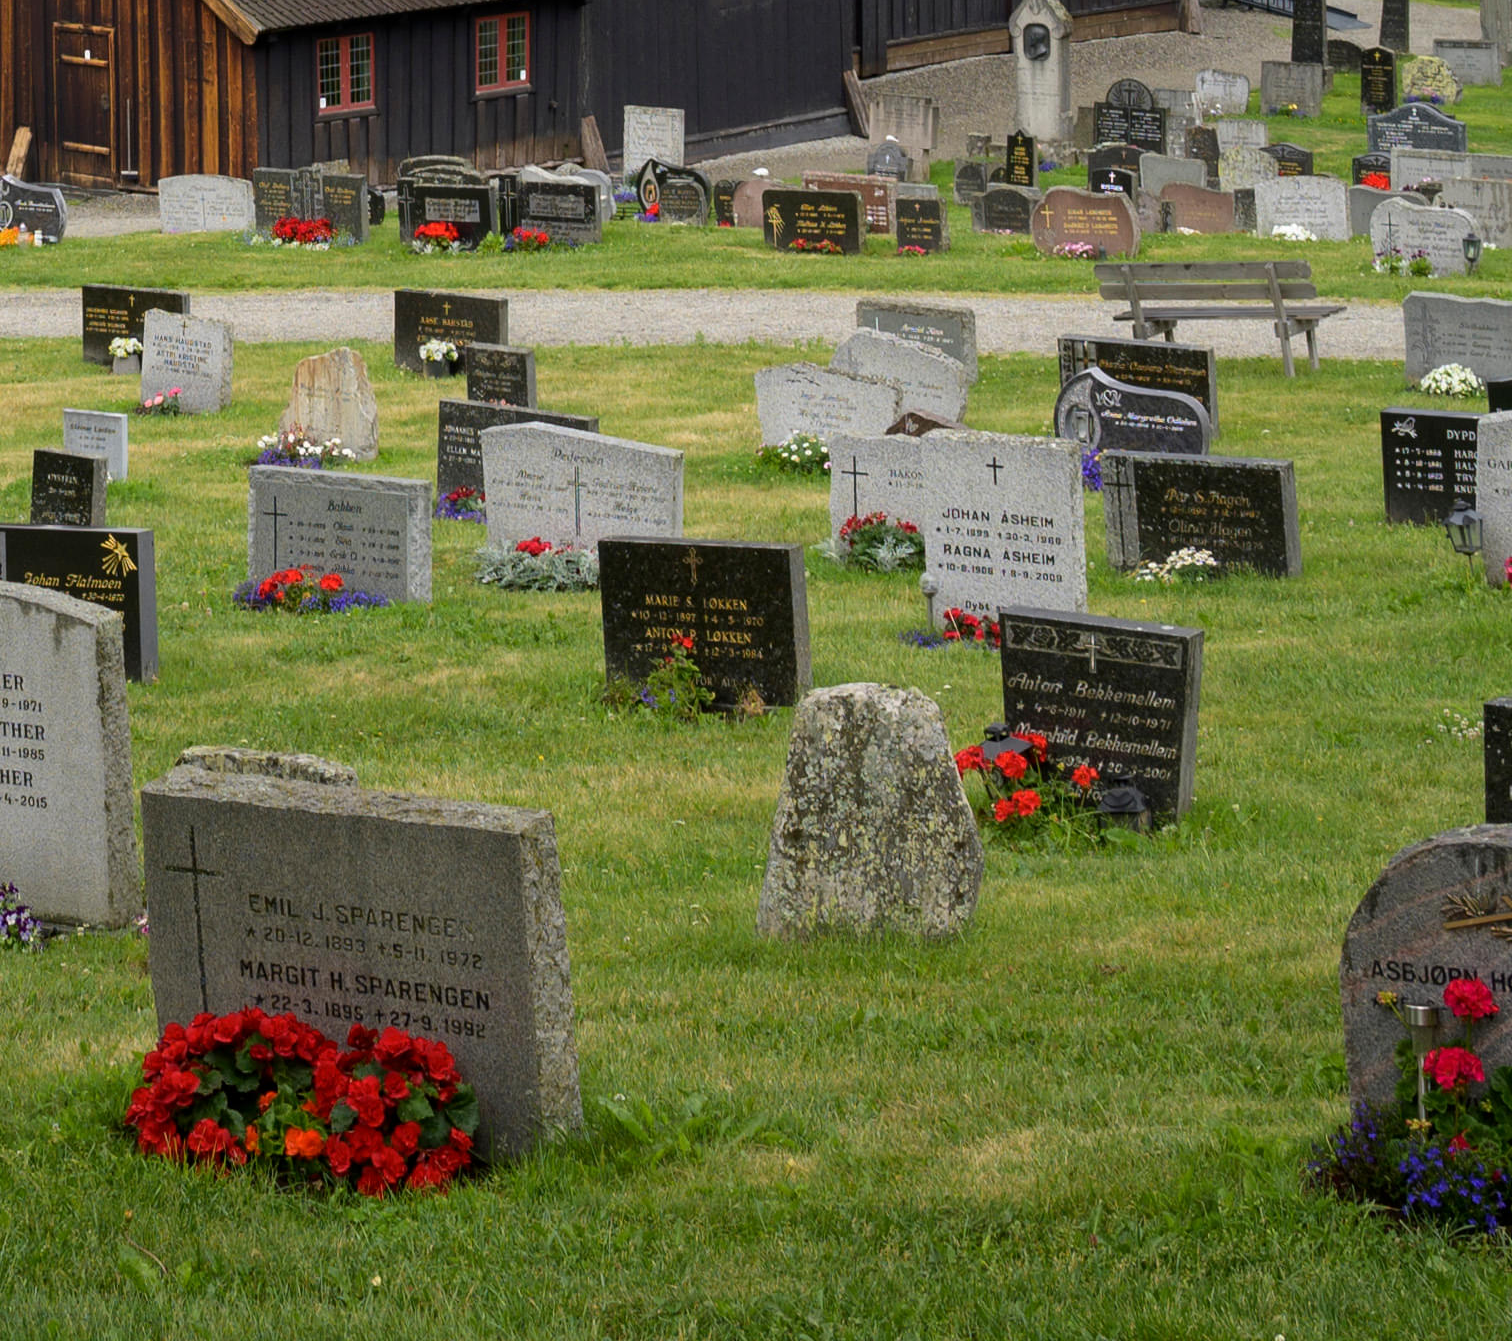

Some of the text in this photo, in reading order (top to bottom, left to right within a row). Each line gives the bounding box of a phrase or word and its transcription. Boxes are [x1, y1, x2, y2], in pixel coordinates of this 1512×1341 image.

[942, 508, 1054, 529] JOHAN ÅSHEIM
[943, 543, 1055, 566] RAGNA ÅSHEIM
[24, 571, 122, 591] Johan Flatmoen
[645, 594, 680, 608] MARIE
[706, 630, 752, 645] LØKKEN
[1068, 680, 1177, 711] Bekkemellem
[1081, 730, 1177, 762] Bekkemellem
[247, 894, 301, 918] EMIL
[239, 959, 491, 1011] MARGIT H. SPARENGEN
